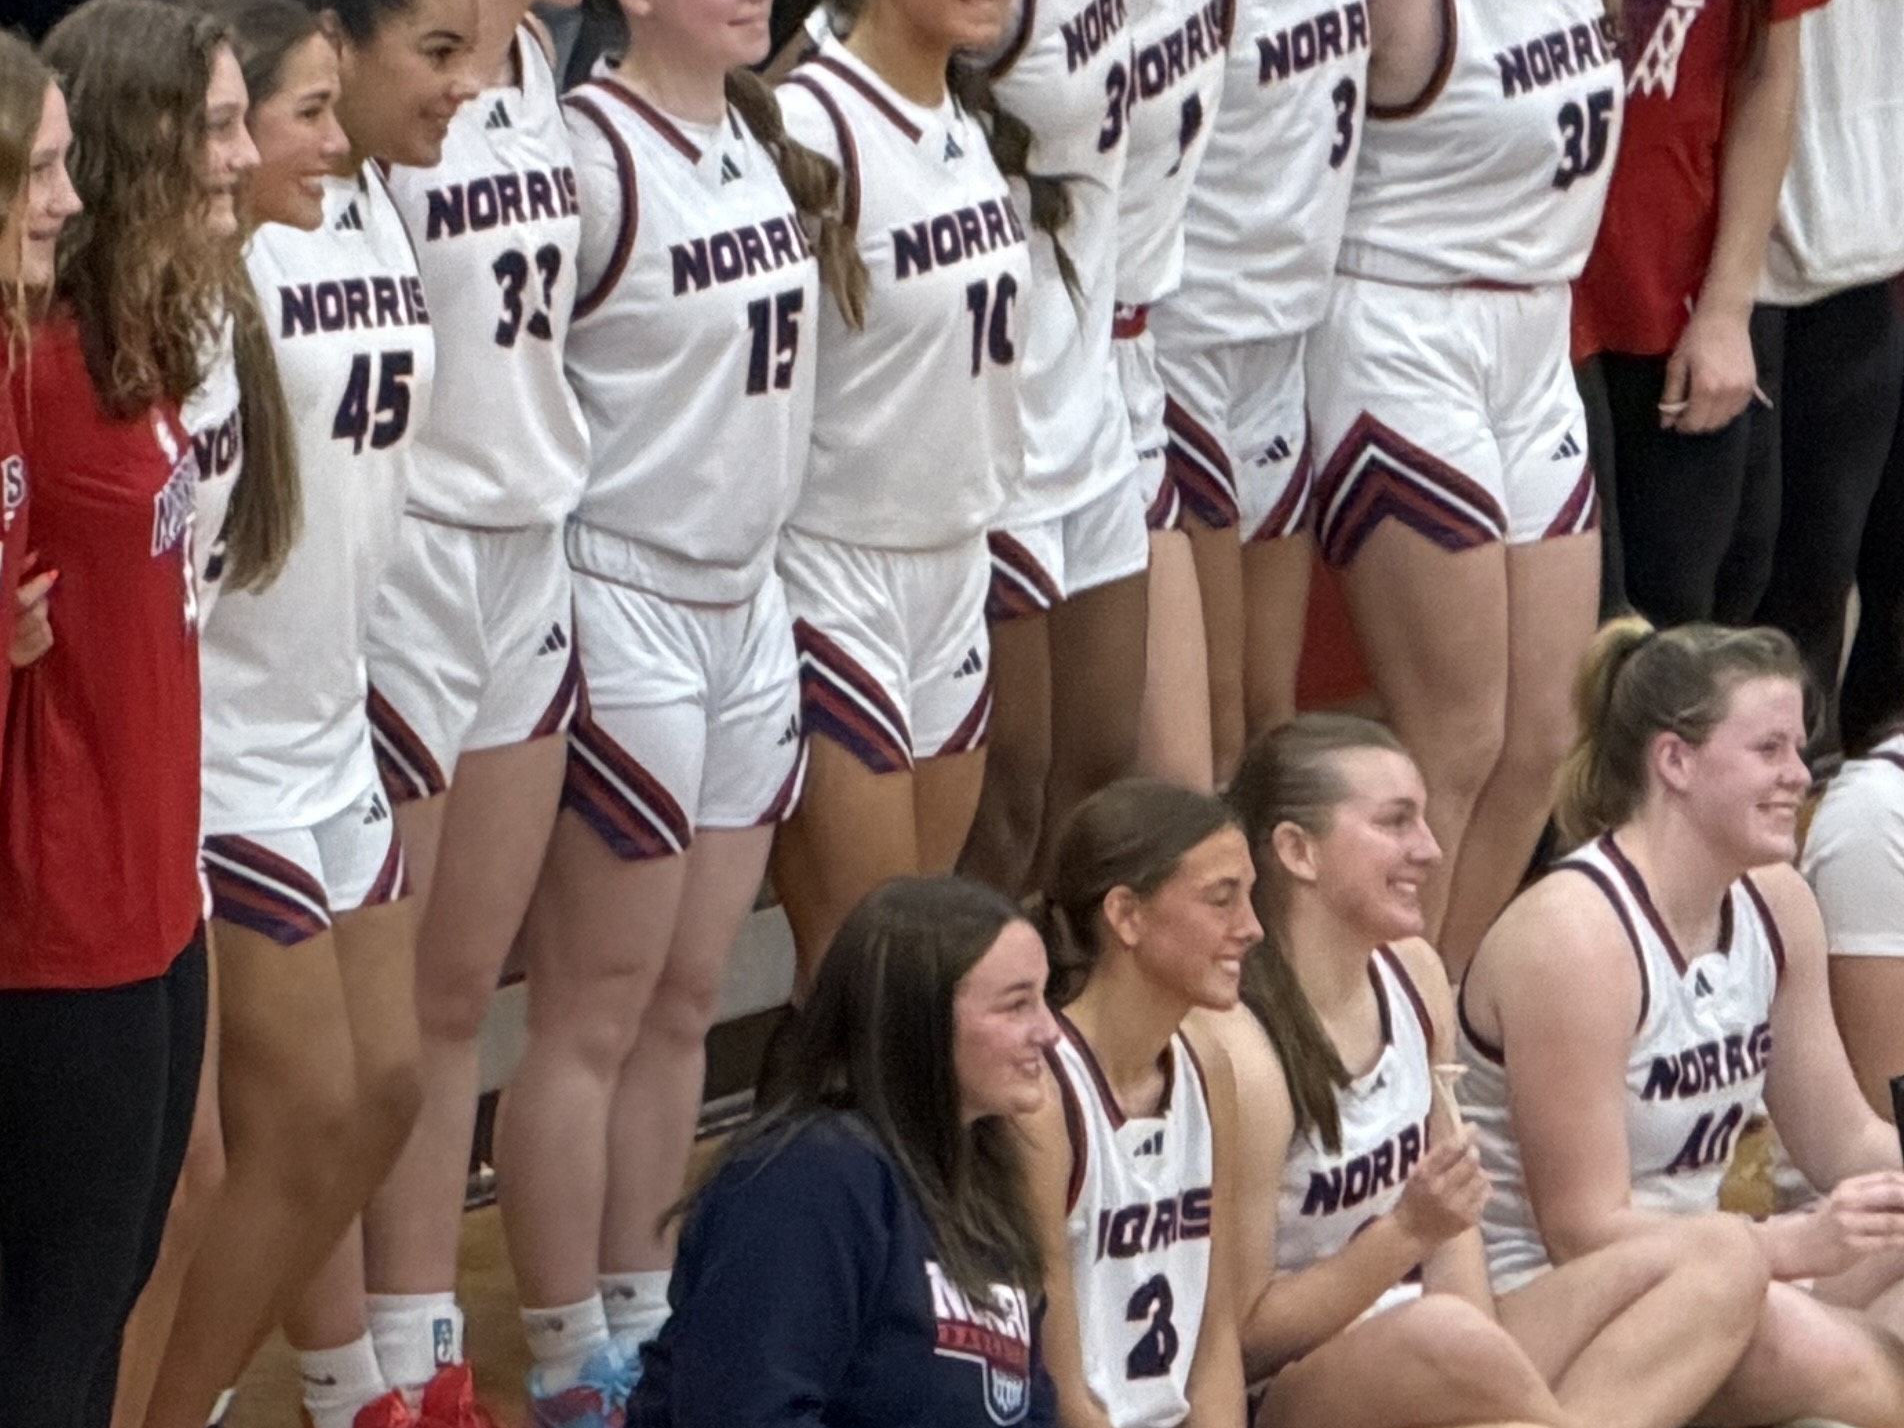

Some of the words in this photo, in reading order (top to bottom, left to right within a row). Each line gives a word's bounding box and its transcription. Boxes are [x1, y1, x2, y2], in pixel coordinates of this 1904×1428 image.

[1329, 76, 1358, 170] 3
[1551, 87, 1614, 190] 35
[425, 166, 580, 243] NORRIS
[277, 276, 431, 339] NORRIS
[491, 242, 562, 348] 33
[746, 286, 804, 396] 15
[965, 271, 1017, 378] 10
[331, 350, 414, 456] 45
[1300, 1117, 1430, 1217] NORR
